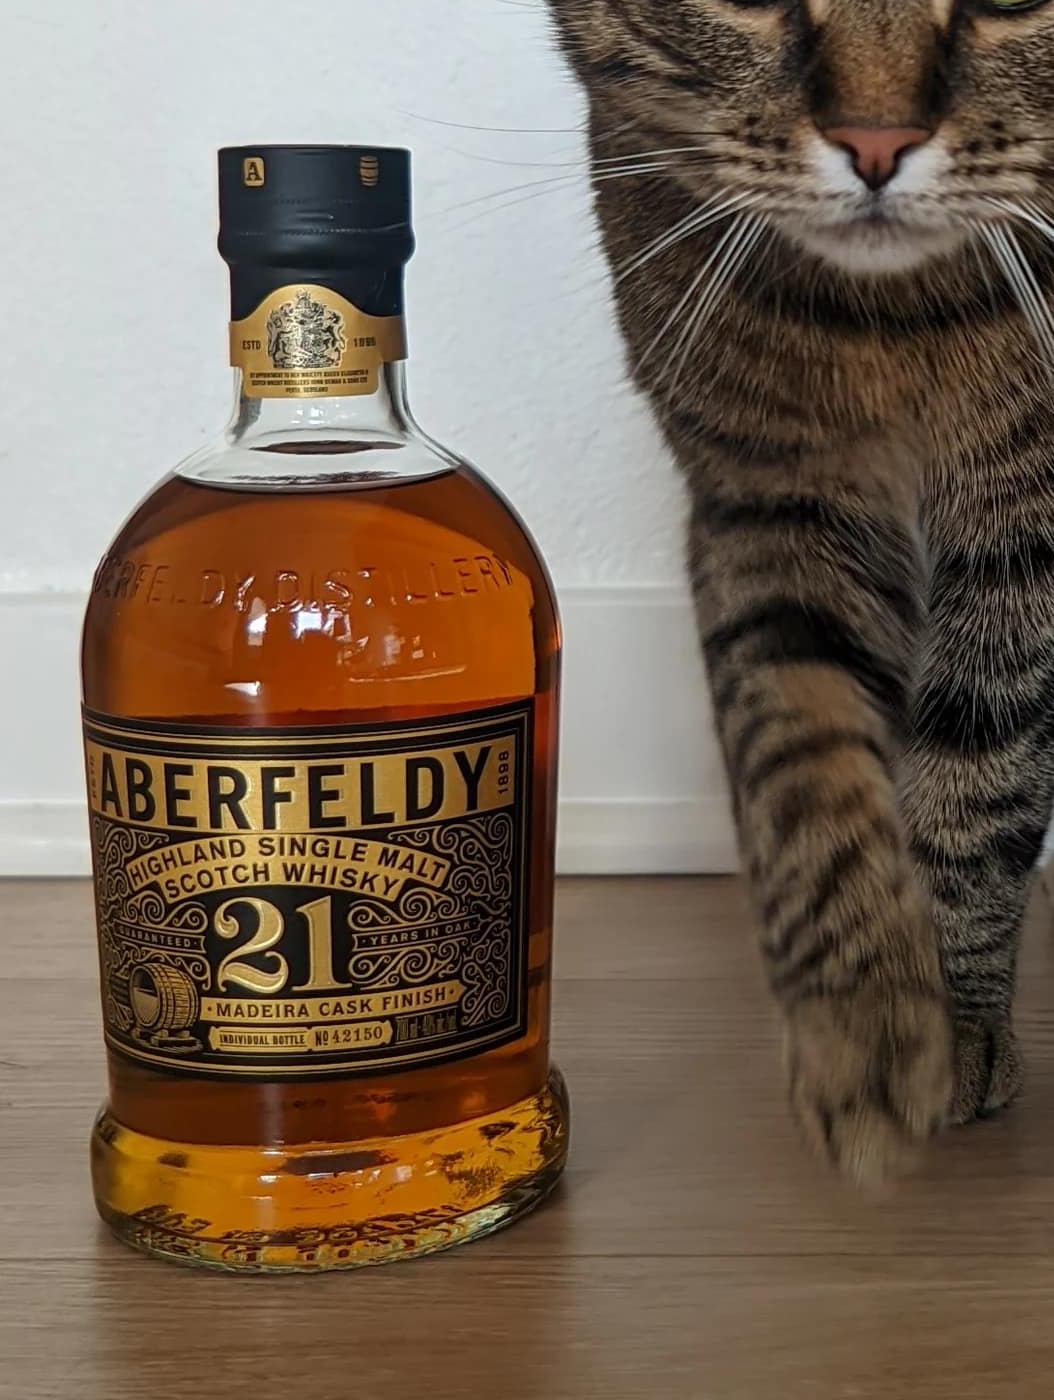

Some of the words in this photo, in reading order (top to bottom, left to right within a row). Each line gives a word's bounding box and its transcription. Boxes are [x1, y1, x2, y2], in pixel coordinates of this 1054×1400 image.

[246, 161, 263, 181] A
[242, 340, 261, 351] ESTD
[498, 750, 510, 795] 1898
[101, 746, 492, 831] ABERFELDY
[129, 839, 246, 887] HIGHLAND
[258, 836, 369, 862] SINGLE
[378, 847, 446, 881] MALT
[165, 863, 270, 899] SCOTCH
[282, 862, 400, 896] WHISKY
[119, 926, 191, 947] GUARANTEED
[214, 895, 353, 994] 21
[370, 931, 419, 946] YEARS
[425, 927, 439, 938] IN
[445, 922, 471, 934] OAK
[216, 1003, 309, 1018] MADEIRA
[319, 1000, 372, 1016] CASK
[381, 987, 446, 1011] FINISH
[219, 1034, 270, 1045] INDIVIDUAL
[272, 1034, 305, 1045] BOTTLE
[332, 1026, 383, 1043] 42150
